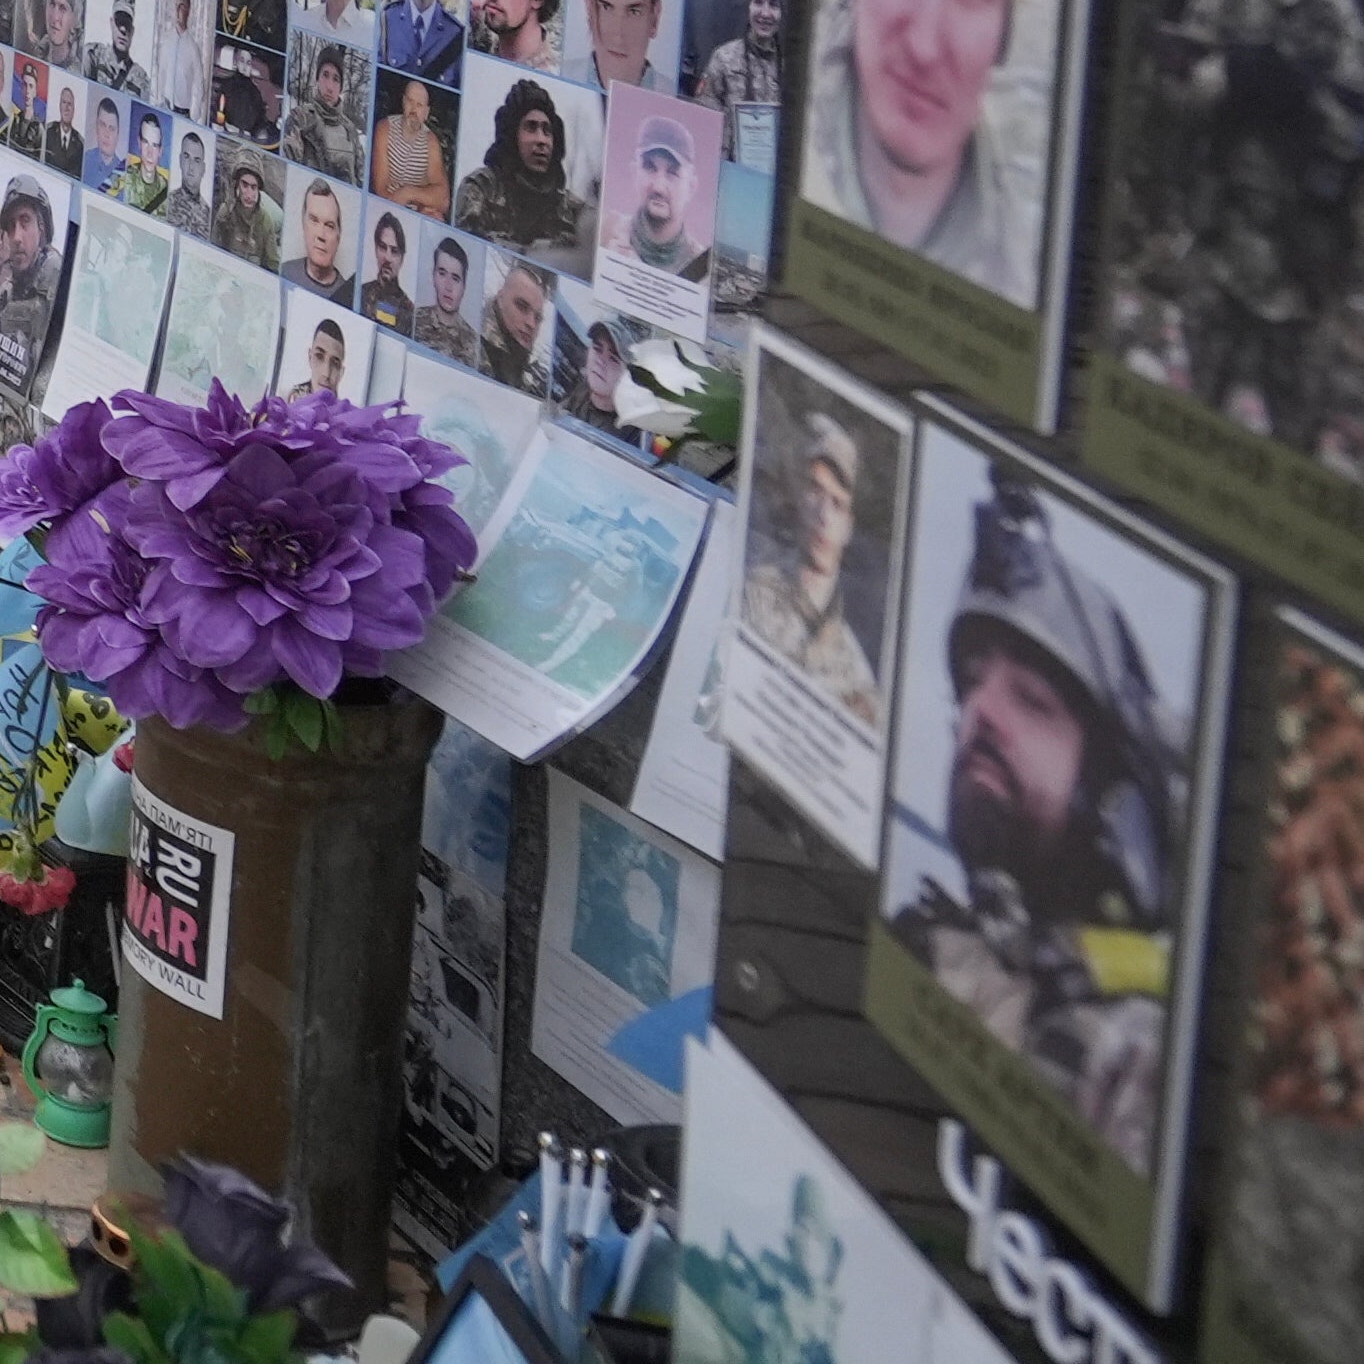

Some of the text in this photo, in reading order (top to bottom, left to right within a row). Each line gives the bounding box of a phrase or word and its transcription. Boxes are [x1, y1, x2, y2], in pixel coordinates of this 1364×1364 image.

[156, 837, 202, 909] RU
[125, 867, 199, 968] WAR
[157, 962, 207, 1001] WALL
